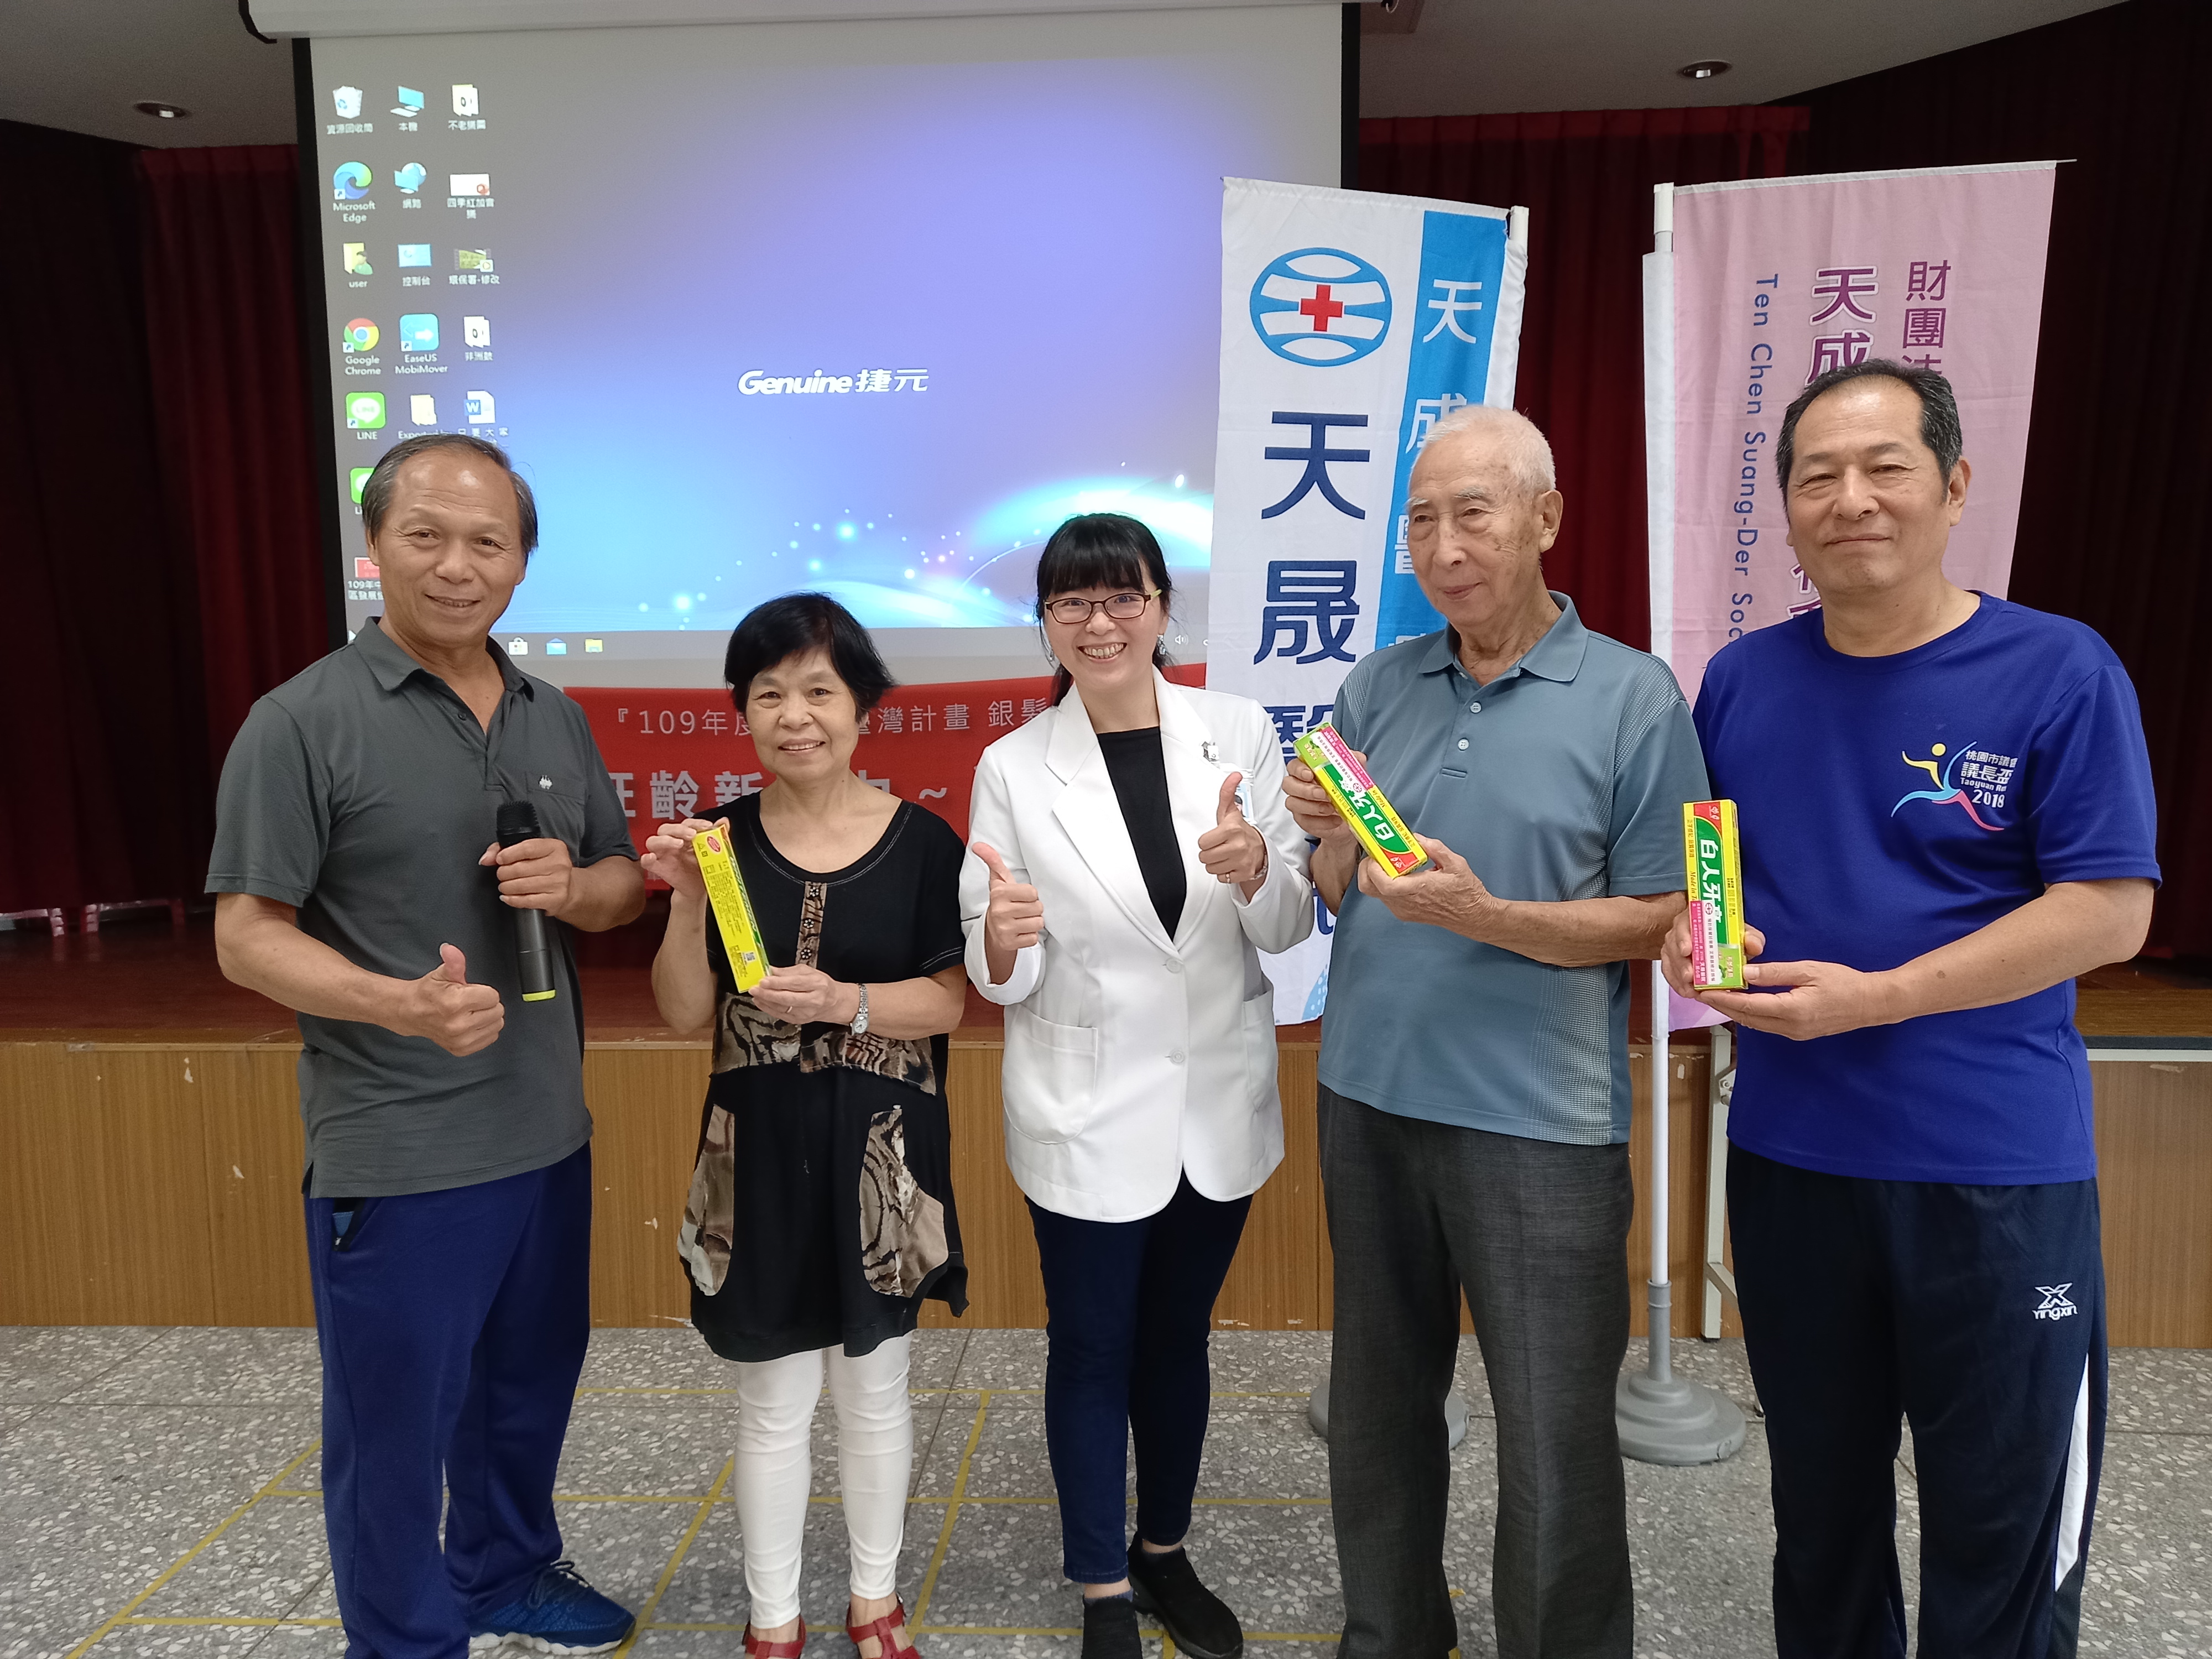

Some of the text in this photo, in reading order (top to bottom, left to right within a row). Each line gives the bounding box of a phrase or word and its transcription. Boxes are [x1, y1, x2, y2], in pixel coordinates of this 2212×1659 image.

[333, 201, 375, 211] Microsoft
[343, 213, 367, 223] Edge
[1754, 273, 1778, 326] Ten
[345, 356, 380, 367] Google
[404, 354, 437, 363] EaseUS
[395, 365, 448, 374] MobiMover
[738, 368, 930, 395] Genuine 捷元
[1746, 343, 1773, 414] Chen
[357, 431, 378, 440] LINE
[1734, 431, 1766, 576] Suang-Der
[1965, 750, 2018, 768] 桃園市議會
[1960, 761, 2014, 784] 議長盃
[1960, 777, 1995, 791] Taoyuan
[1971, 789, 2005, 808] 2018
